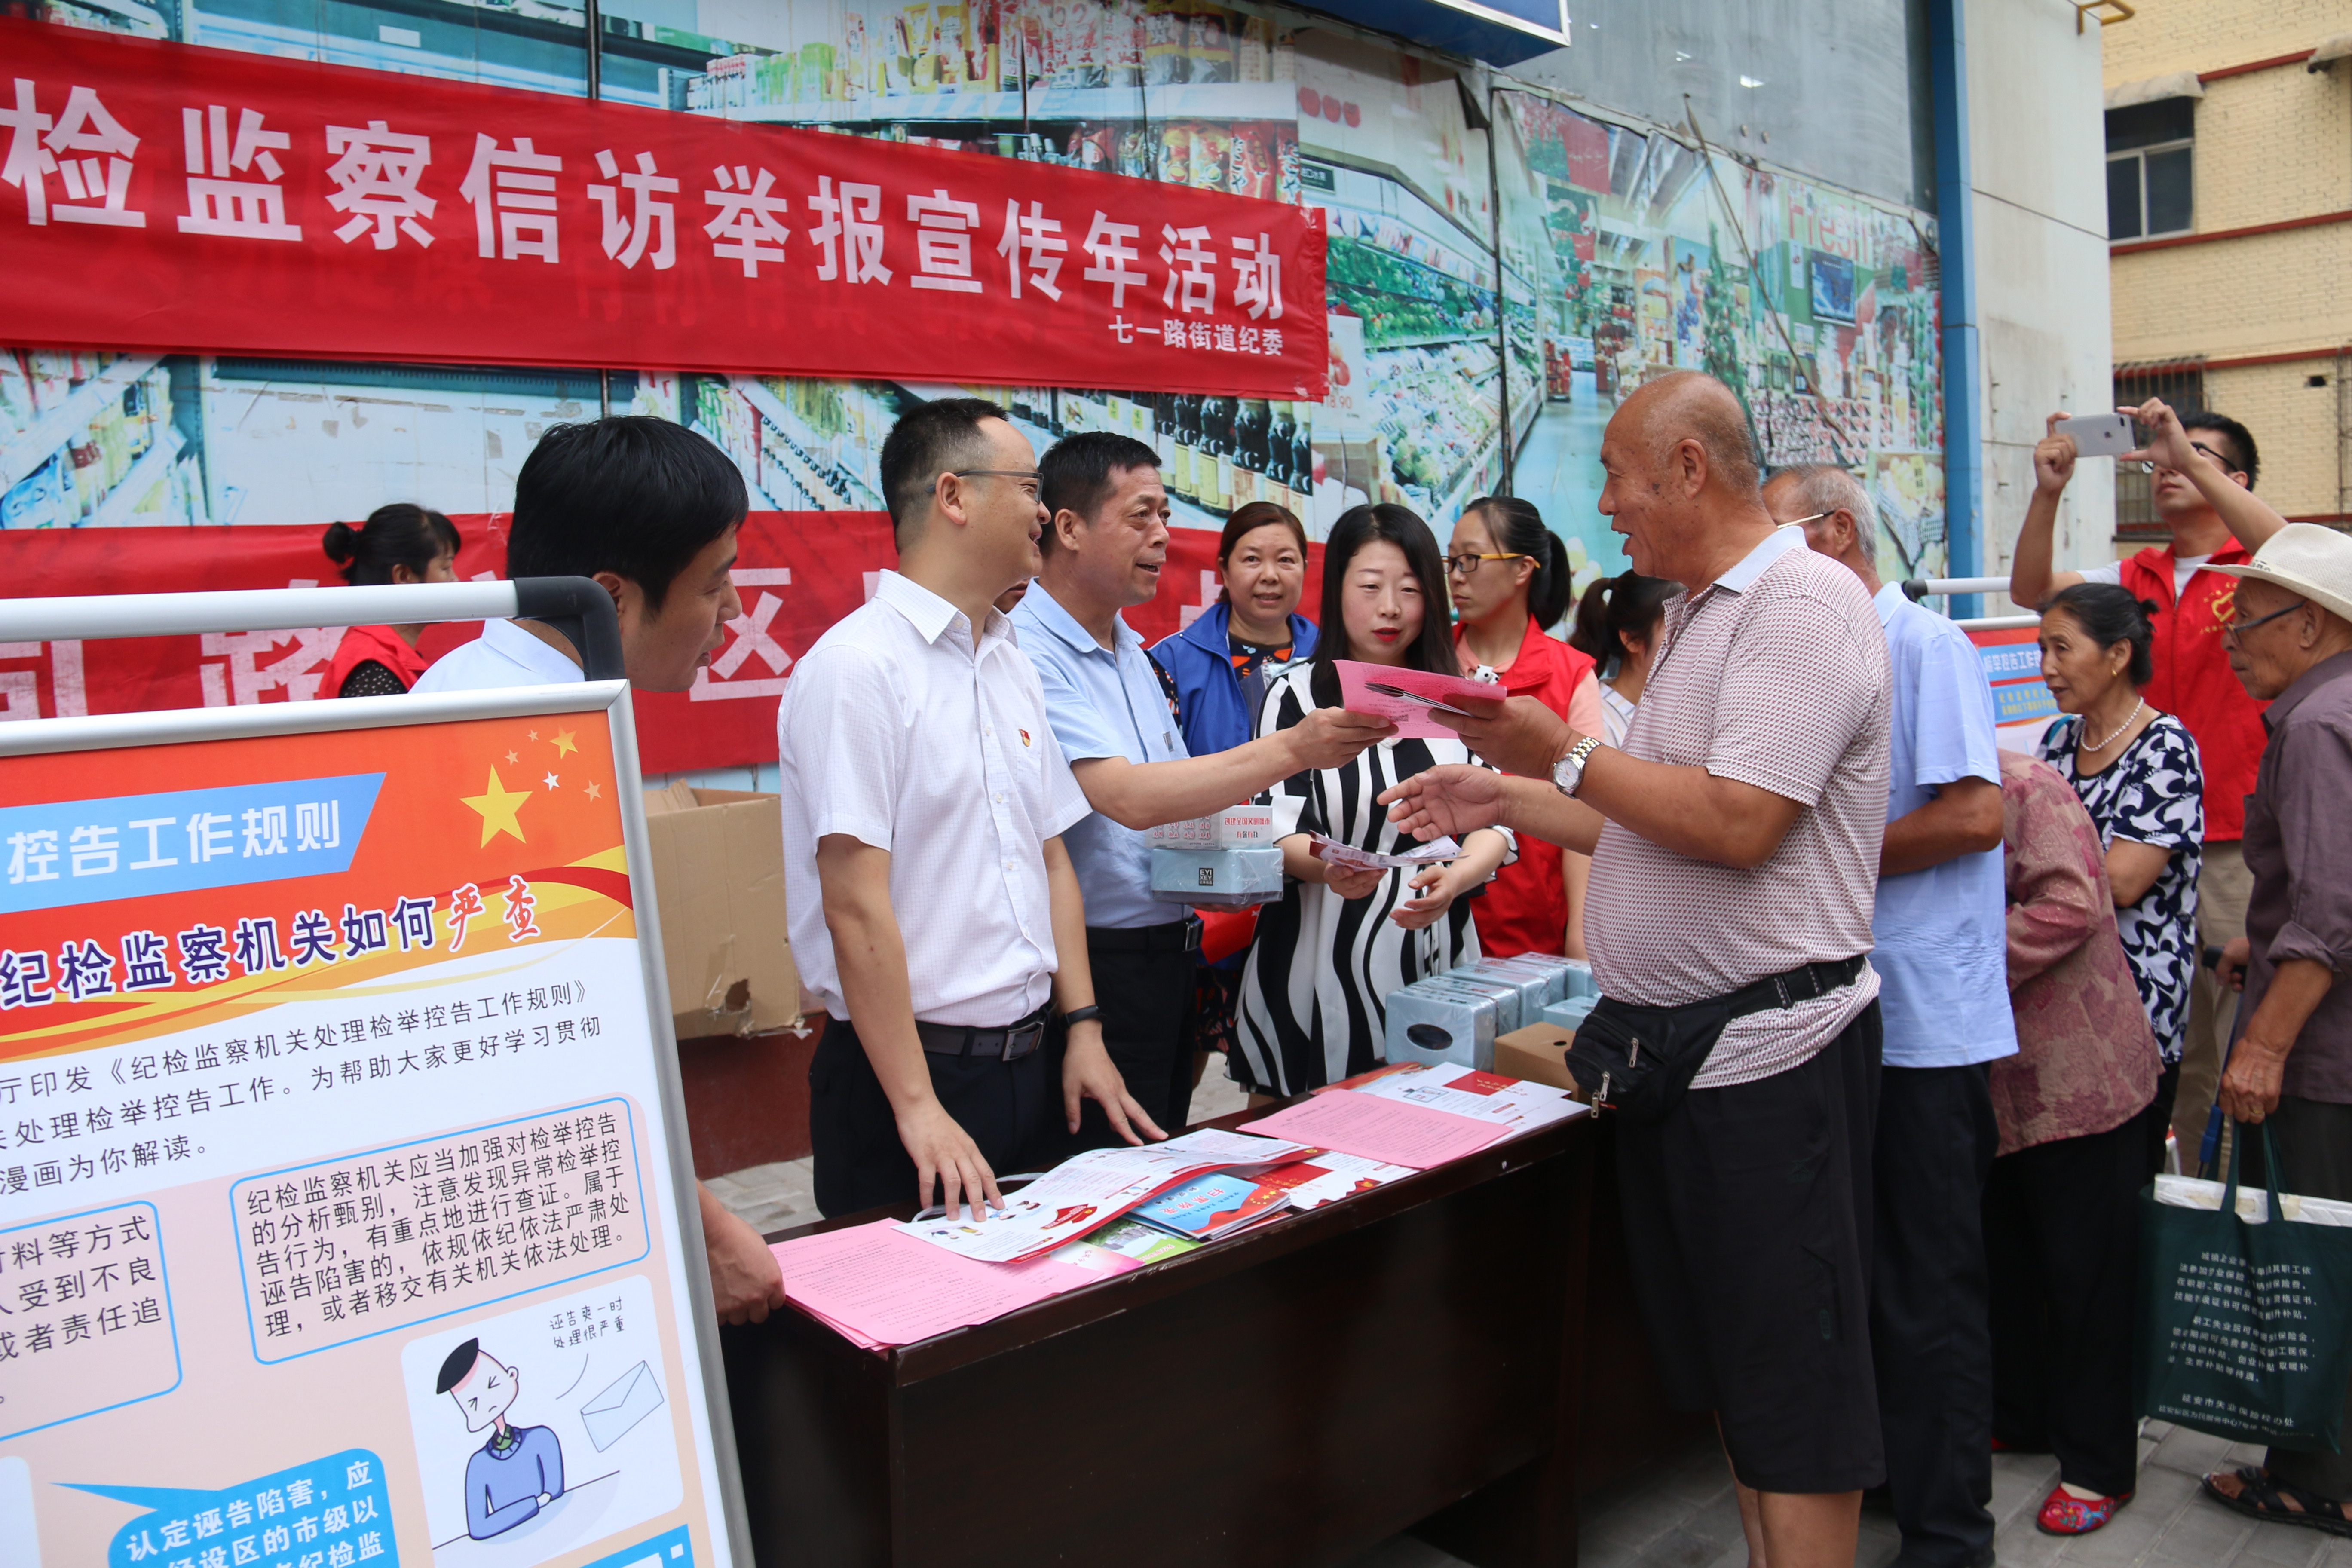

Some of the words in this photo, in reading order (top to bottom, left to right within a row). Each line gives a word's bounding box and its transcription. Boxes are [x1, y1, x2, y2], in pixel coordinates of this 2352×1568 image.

[0, 78, 1283, 320] 检监察信访举报宣传年活动
[1109, 315, 1283, 357] 七一路街道纪委
[6, 799, 341, 885] 控告工作规则
[1224, 817, 1270, 825] 创建全国文明城市
[0, 980, 585, 1105] 厅印发《纪检监察机关处理检举控告工作规则》
[0, 1134, 205, 1194] 漫画为你解读。
[247, 1111, 616, 1216] 纪检监察机关应当加强对检举控告
[252, 1138, 622, 1247] 的分析甄别，注意发现异常检举控
[1157, 1188, 1225, 1215] 扫黑除恶
[0, 1215, 150, 1274] 料等方式
[257, 1165, 624, 1277] 告行为，有重点地进行查证。属于
[260, 1191, 629, 1307] 诬告陷害的，依规依纪依法严肃处
[264, 1224, 622, 1337] 理，或者移交有关机关依法处理。
[549, 1295, 622, 1330] 诬告爽一时
[554, 1315, 625, 1348] 处理很严重
[126, 1460, 373, 1562] 认定诬告陷害，应
[273, 1531, 385, 1568] 纪检监
